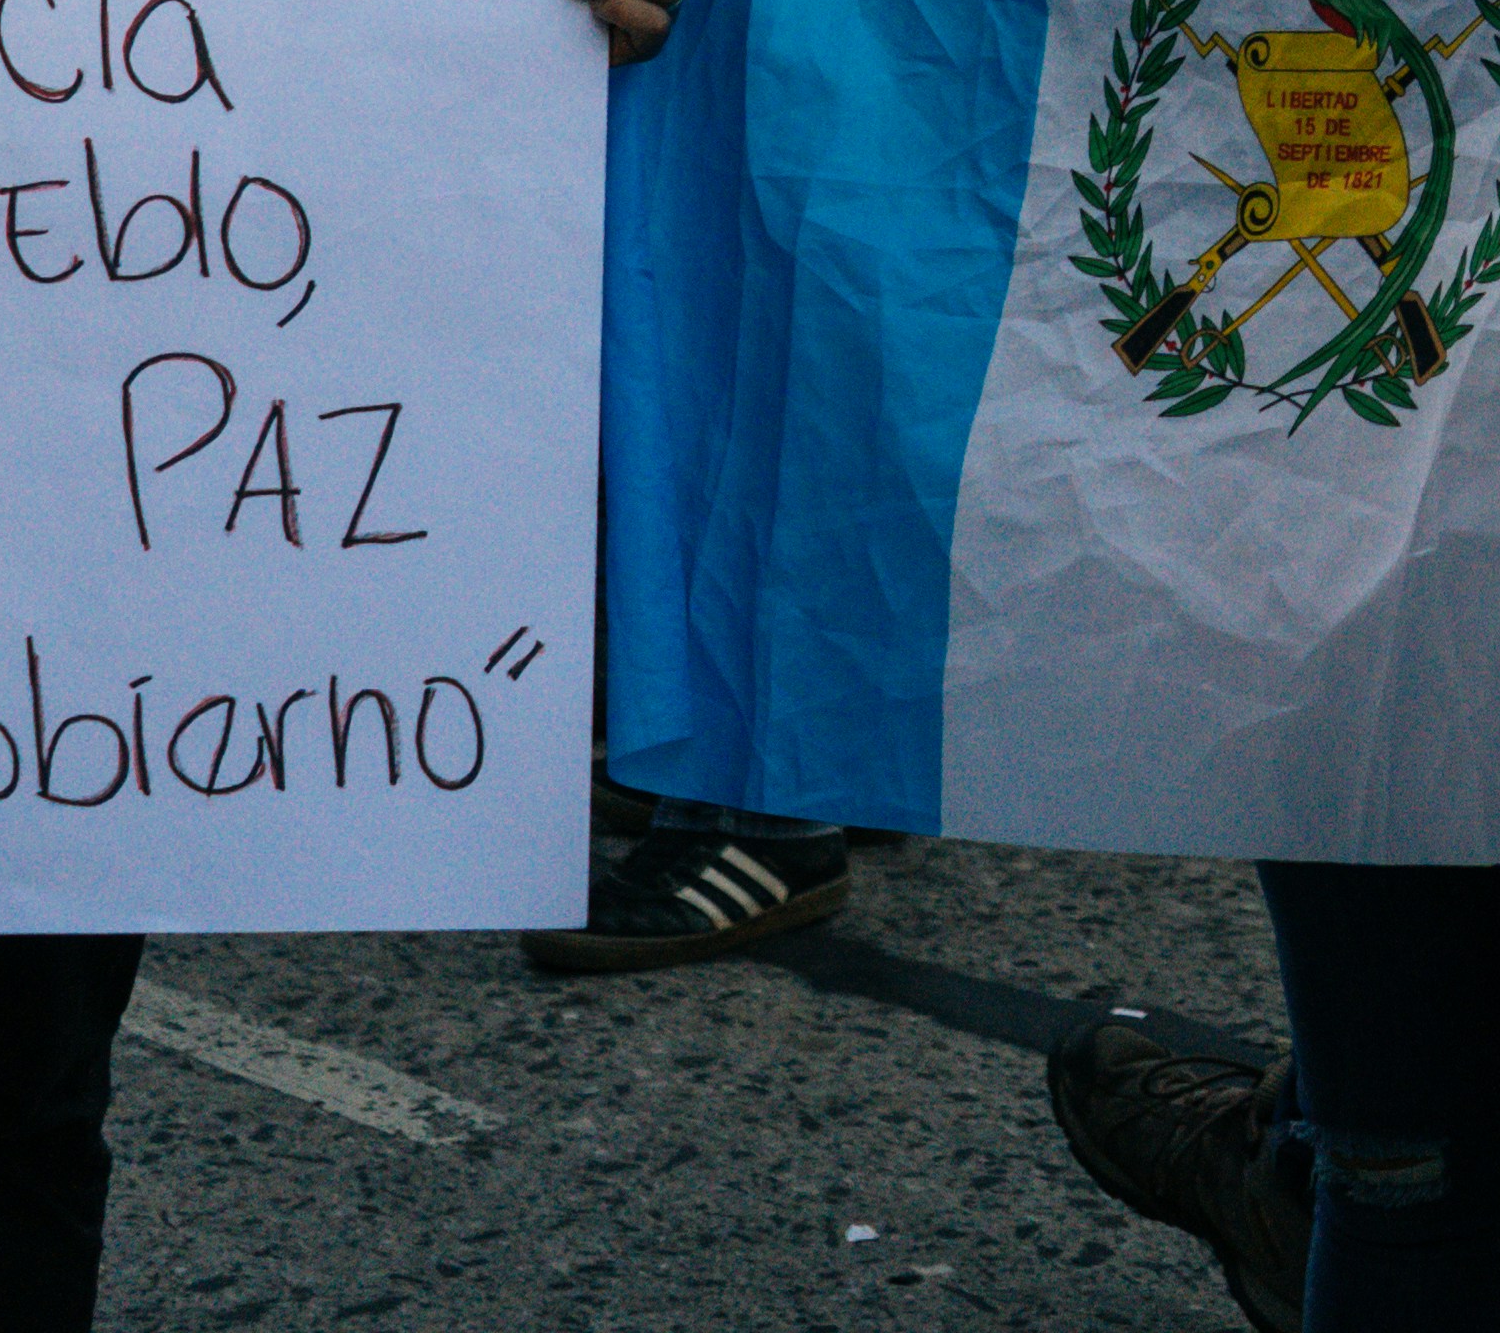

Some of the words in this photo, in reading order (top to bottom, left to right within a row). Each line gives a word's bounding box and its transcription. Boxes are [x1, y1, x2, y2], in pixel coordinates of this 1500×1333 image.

[1266, 90, 1359, 111] LIBERTAD
[1294, 117, 1316, 137] 15
[1325, 118, 1352, 137] DE
[1276, 142, 1393, 163] SEPTIEMBRE
[1306, 172, 1332, 190] DE
[1342, 171, 1384, 191] 1821
[120, 350, 429, 552] PAZ
